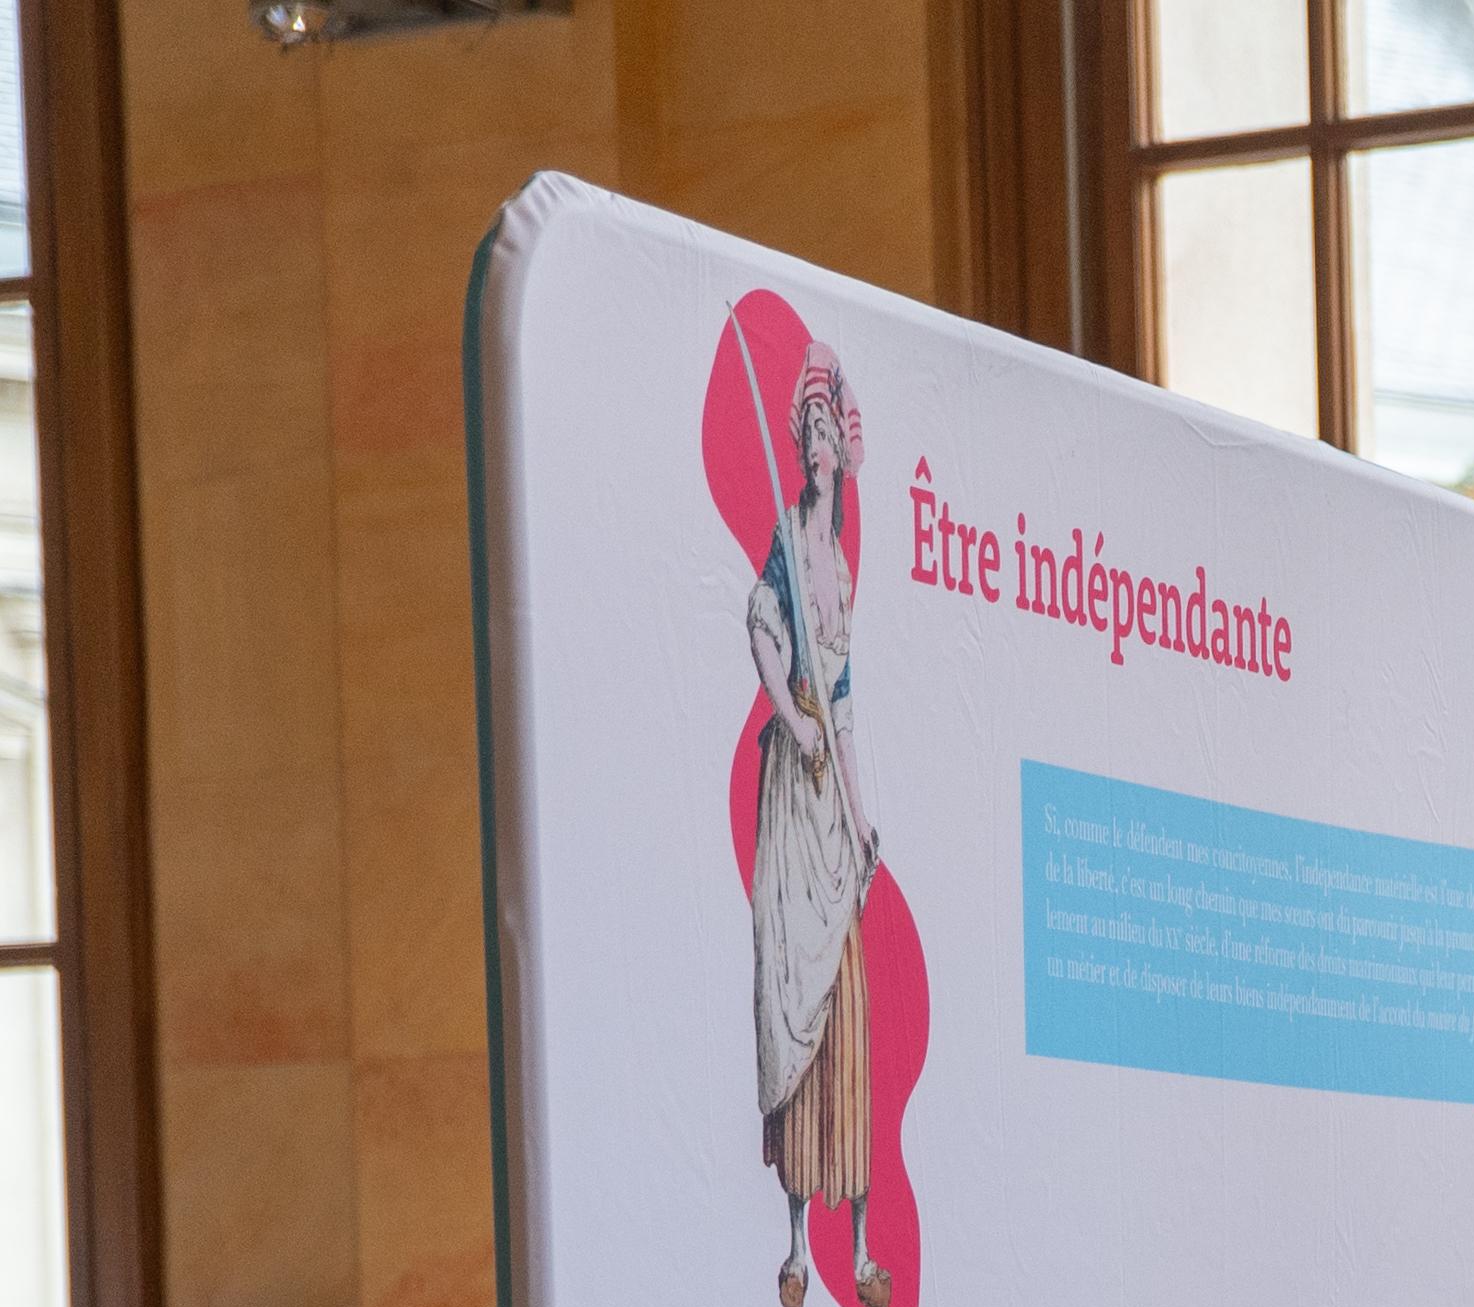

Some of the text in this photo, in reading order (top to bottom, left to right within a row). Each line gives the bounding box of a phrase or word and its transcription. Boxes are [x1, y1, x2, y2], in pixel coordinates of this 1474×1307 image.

[909, 455, 1292, 682] Être indépendante
[1064, 817, 1109, 846] comme
[1127, 819, 1184, 860] défendent
